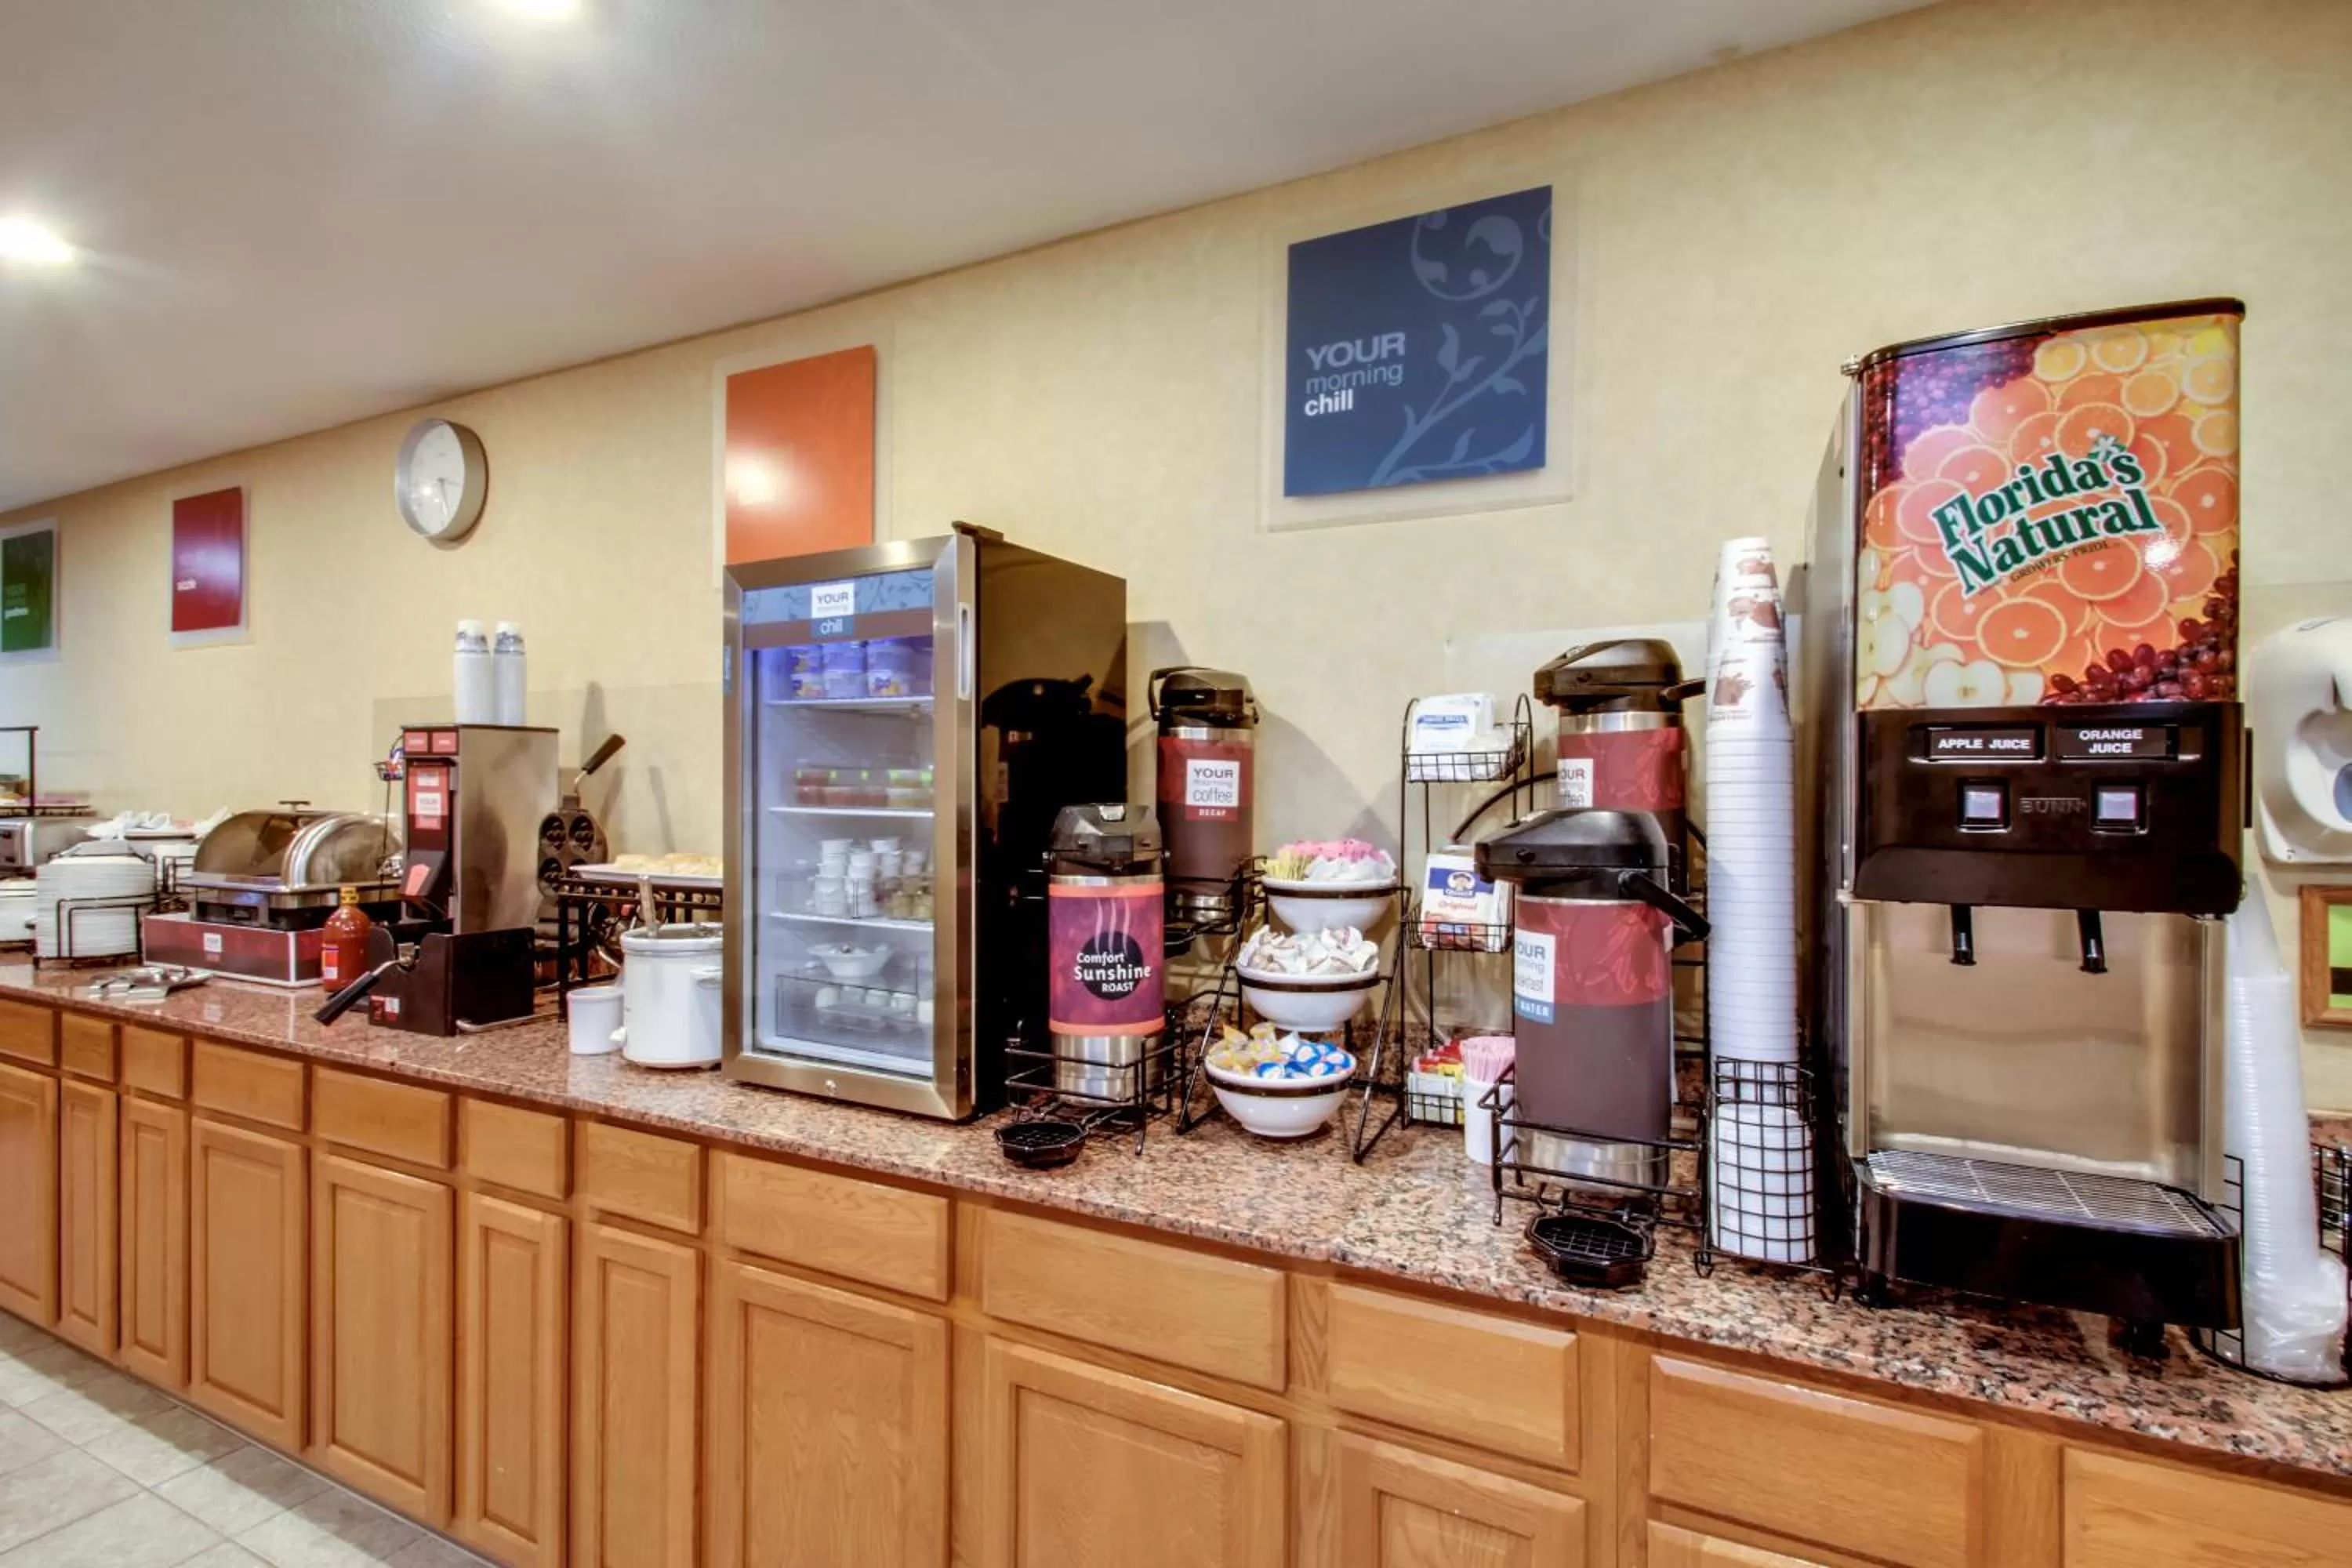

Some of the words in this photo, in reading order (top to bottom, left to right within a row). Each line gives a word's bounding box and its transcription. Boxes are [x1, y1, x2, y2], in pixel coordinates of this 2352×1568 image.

[1305, 332, 1406, 371] YOUR
[1306, 363, 1404, 394] morning
[1305, 388, 1354, 416] chill
[1931, 452, 2144, 549] Florida's
[1951, 488, 2161, 596] Natural
[817, 592, 848, 604] YOUR
[821, 618, 843, 634] chill
[2078, 729, 2143, 740] ORANGE
[1938, 739, 1983, 749] APPLE
[1989, 739, 2031, 749] JUICE
[2089, 743, 2132, 753] JUICE
[1193, 768, 1234, 779] YOUR
[1192, 786, 1233, 804] coffee
[1076, 951, 1125, 965] Comfort
[1073, 964, 1152, 981] Sunshine
[1102, 982, 1134, 993] ROAST
